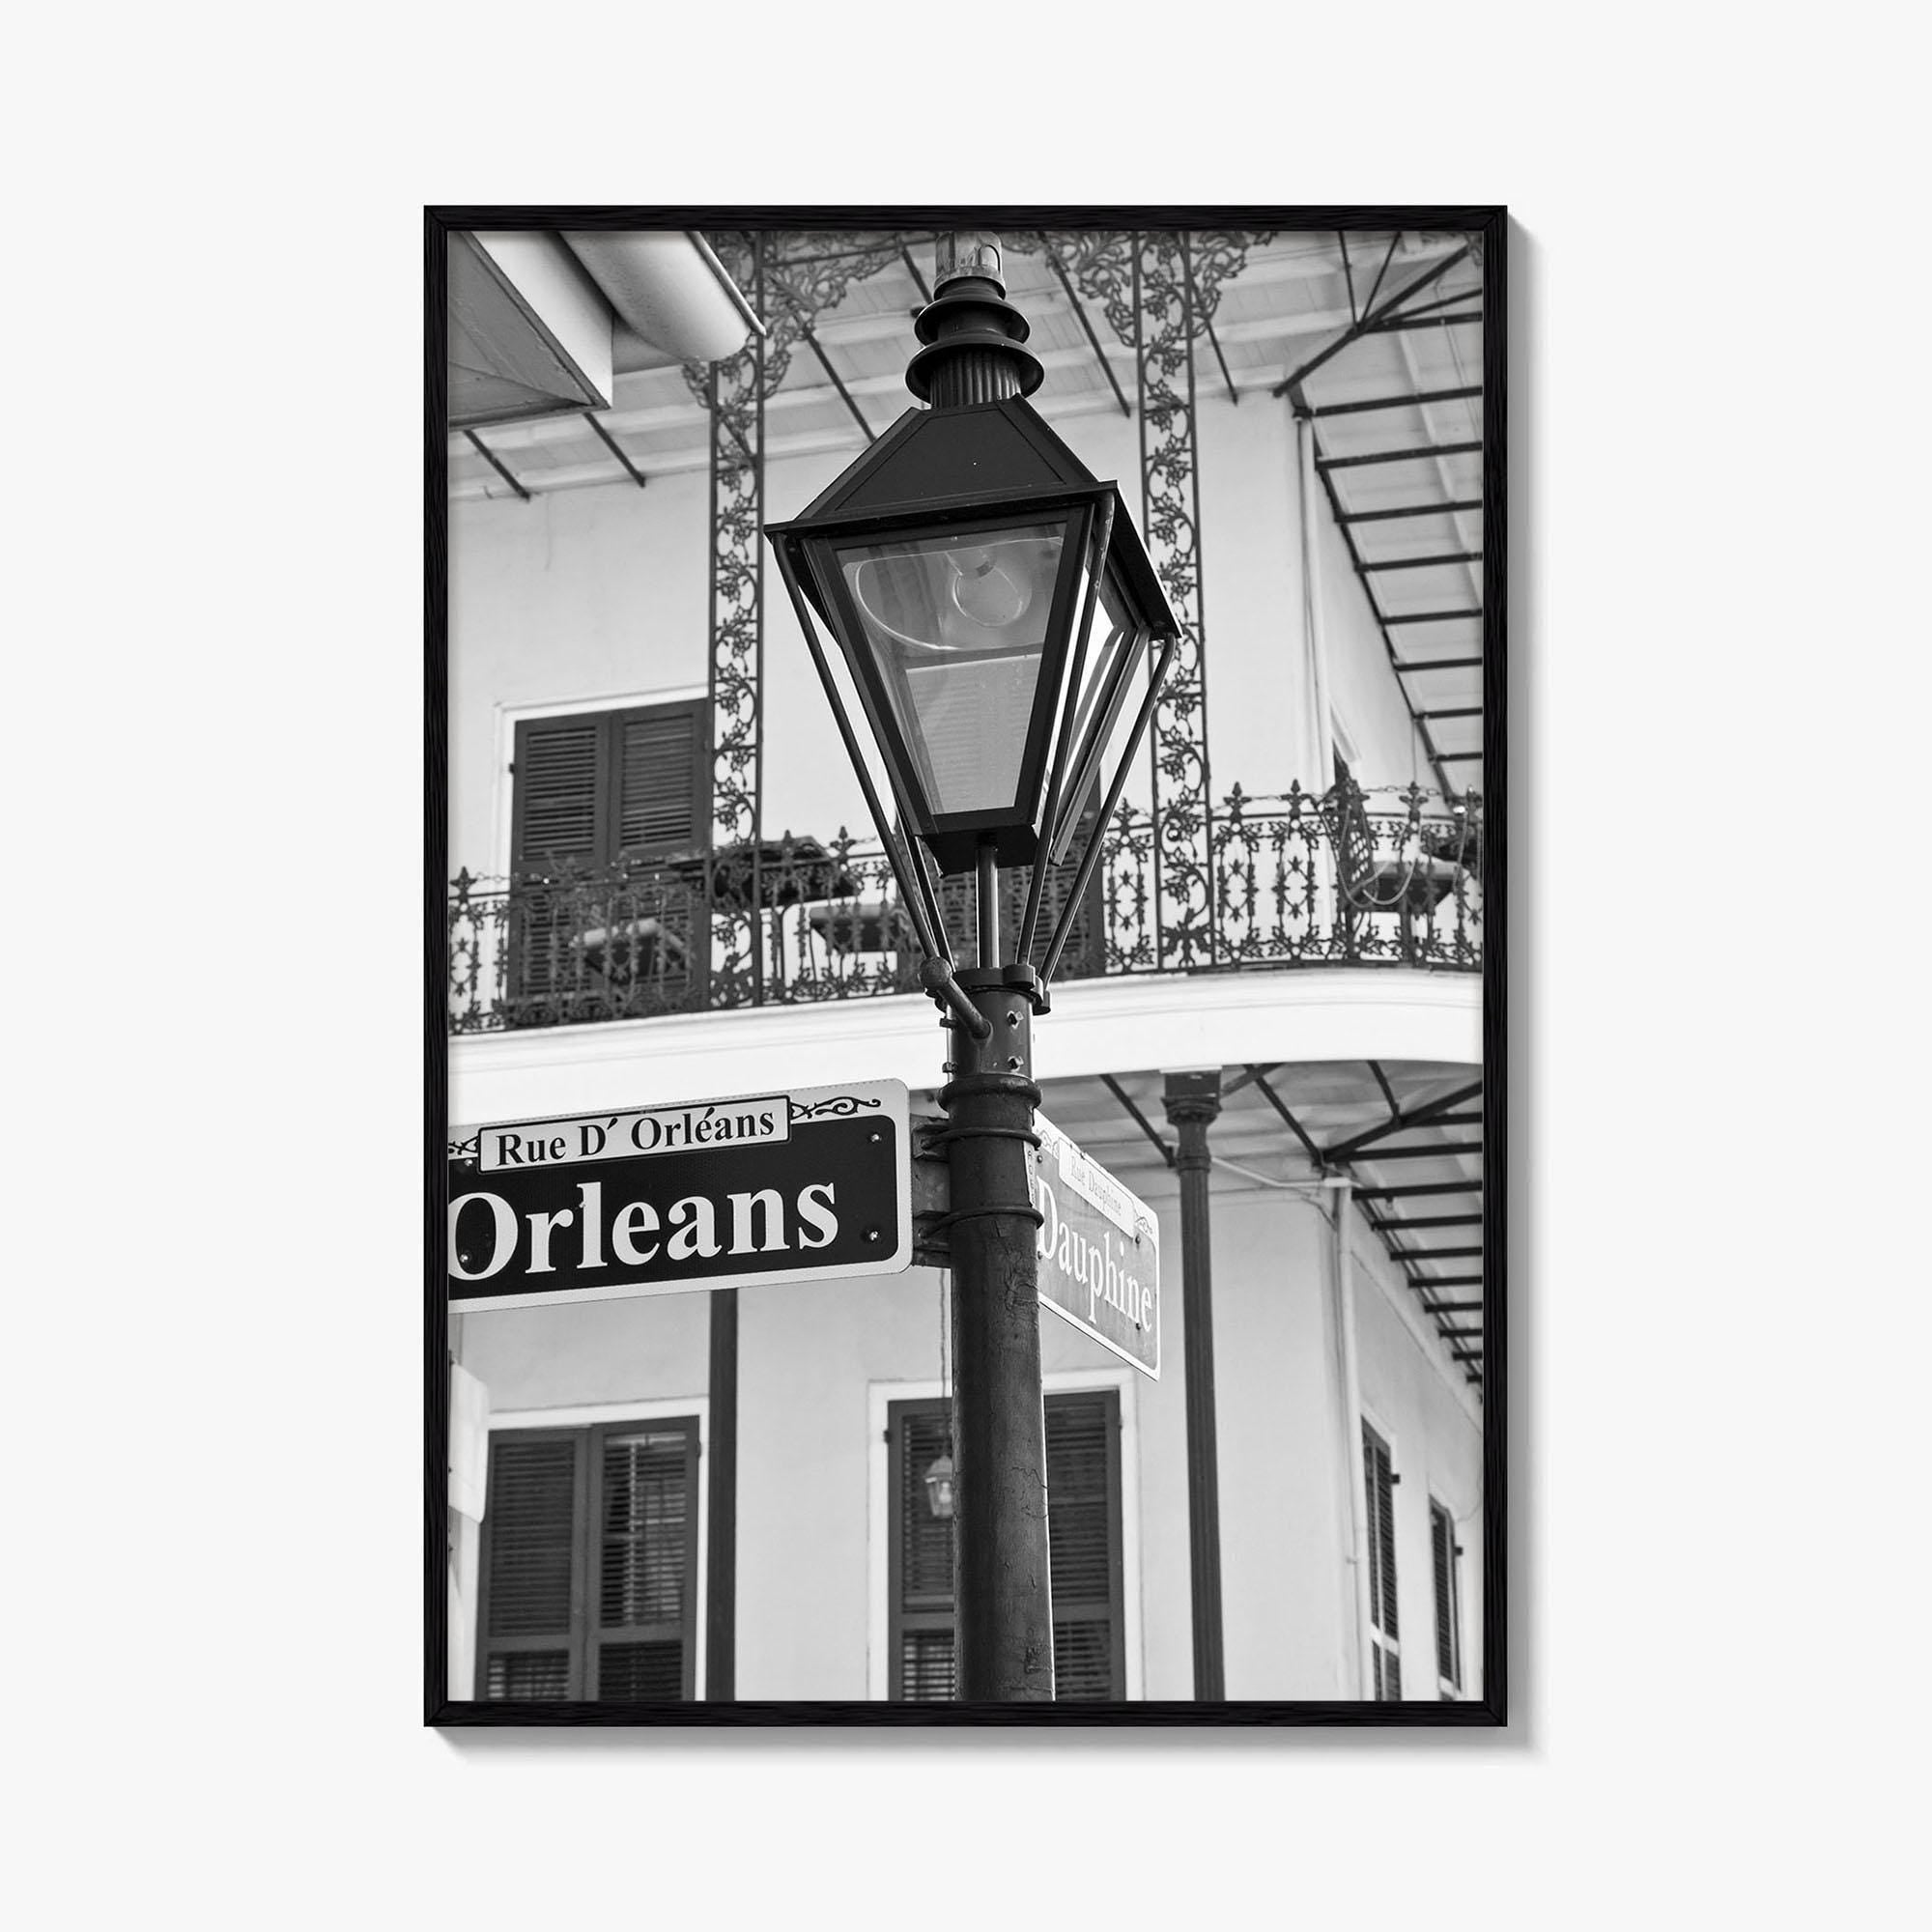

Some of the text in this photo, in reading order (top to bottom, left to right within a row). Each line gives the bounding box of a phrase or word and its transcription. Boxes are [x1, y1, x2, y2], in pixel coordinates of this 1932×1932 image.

[496, 1133, 566, 1167] Rue
[631, 1107, 774, 1150] Orléans
[448, 1181, 839, 1281] Orleans
[1037, 1176, 1152, 1333] Dauphine
